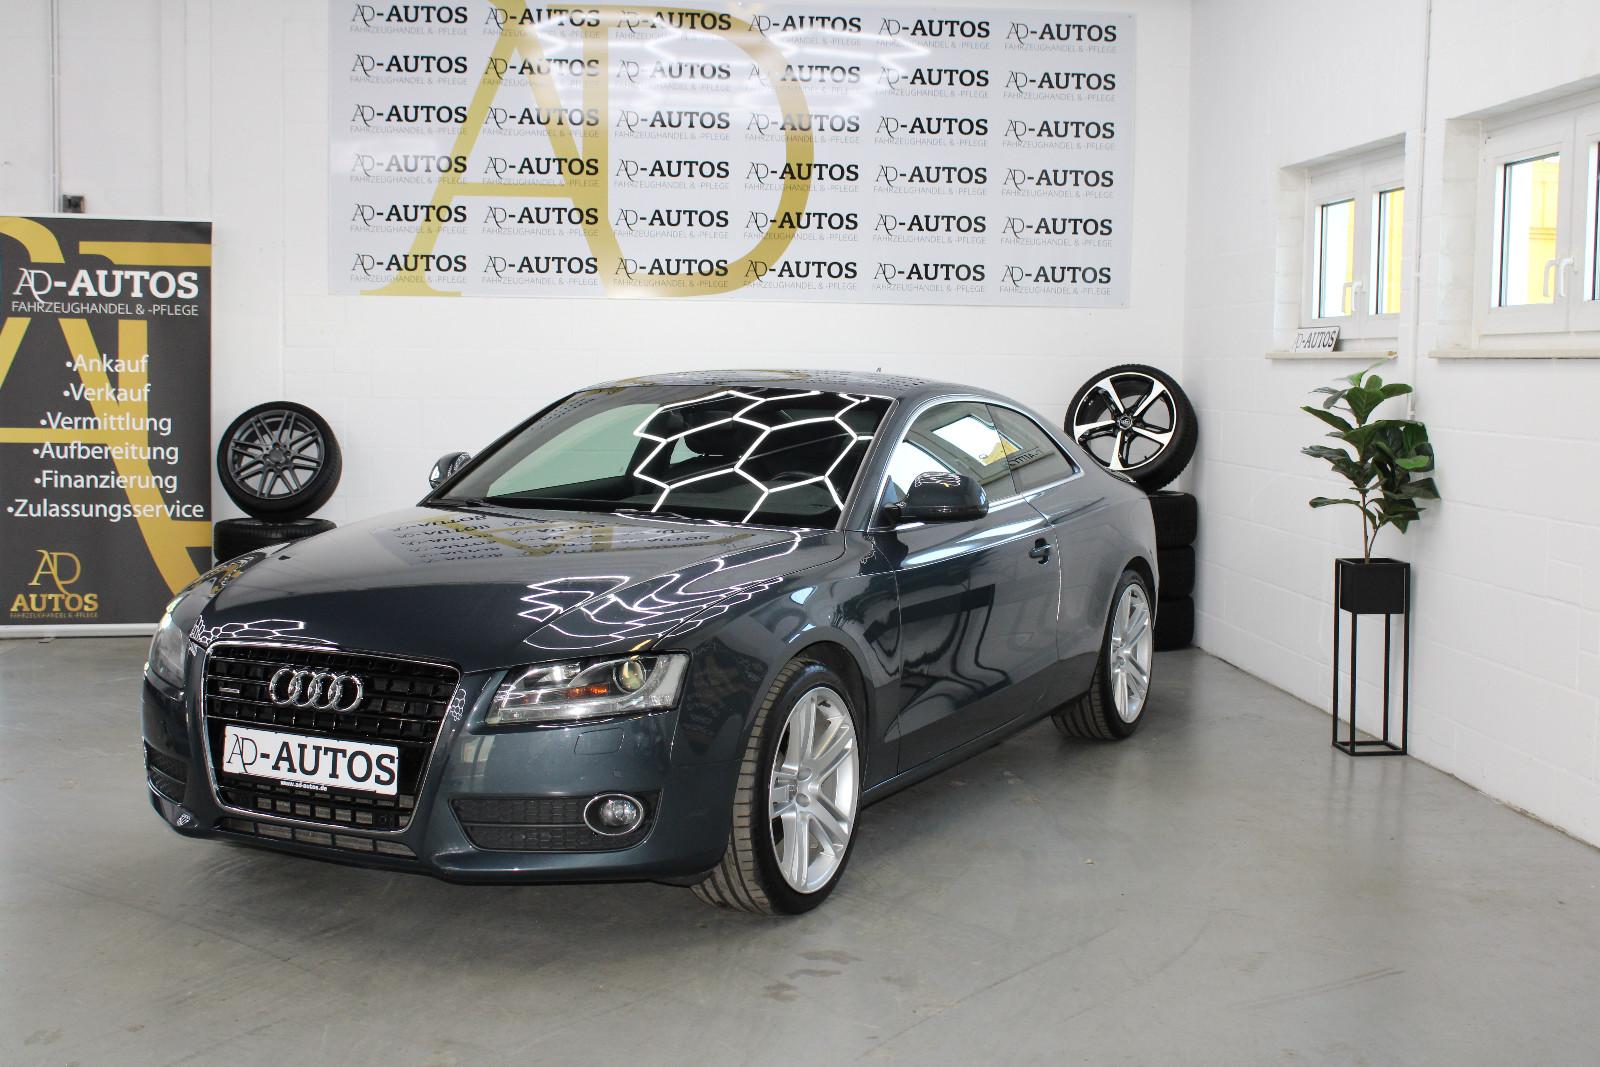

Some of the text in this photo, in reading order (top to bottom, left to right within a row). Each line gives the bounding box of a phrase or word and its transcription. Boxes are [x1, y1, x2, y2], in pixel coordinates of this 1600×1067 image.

[352, 4, 468, 28] AD-AUTOS
[878, 18, 990, 40] AD-AUTOS
[1007, 21, 1117, 44] AD-AUTOS
[351, 54, 467, 77] AD-AUTOS
[1005, 70, 1116, 92] AD-AUTOS
[351, 104, 467, 127] AD-AUTOS
[484, 106, 599, 130] AD-AUTOS
[616, 109, 730, 133] AD-AUTOS
[746, 112, 860, 136] AD-AUTOS
[876, 116, 988, 138] AD-AUTOS
[1004, 119, 1114, 141] AD-AUTOS
[351, 153, 467, 177] AD-AUTOS
[484, 156, 599, 180] AD-AUTOS
[615, 159, 730, 182] AD-AUTOS
[746, 162, 859, 185] AD-AUTOS
[875, 164, 987, 187] AD-AUTOS
[1003, 167, 1113, 190] AD-AUTOS
[351, 203, 467, 227] AD-AUTOS
[484, 206, 599, 229] AD-AUTOS
[615, 208, 729, 231] AD-AUTOS
[745, 211, 858, 234] AD-AUTOS
[874, 213, 986, 236] AD-AUTOS
[1002, 216, 1112, 239] AD-AUTOS
[351, 253, 466, 276] AD-AUTOS
[484, 255, 598, 278] AD-AUTOS
[615, 257, 729, 281] AD-AUTOS
[745, 260, 858, 283] AD-AUTOS
[873, 262, 985, 285] AD-AUTOS
[1001, 265, 1111, 287] AD-AUTOS
[13, 268, 199, 303] AD-AUTOS
[11, 301, 199, 316] FAHRZEUGHANDEL & -PFLEGE
[73, 354, 150, 373] Ankauf
[70, 383, 151, 401] Verkauf
[46, 411, 172, 436] Vermittlung
[39, 441, 179, 465] Aufbereitung
[41, 469, 178, 493] Finanzierung
[14, 498, 204, 522] Zulassungsservice
[10, 593, 98, 612] AUTOS
[226, 733, 396, 785] AD-AUTOS
